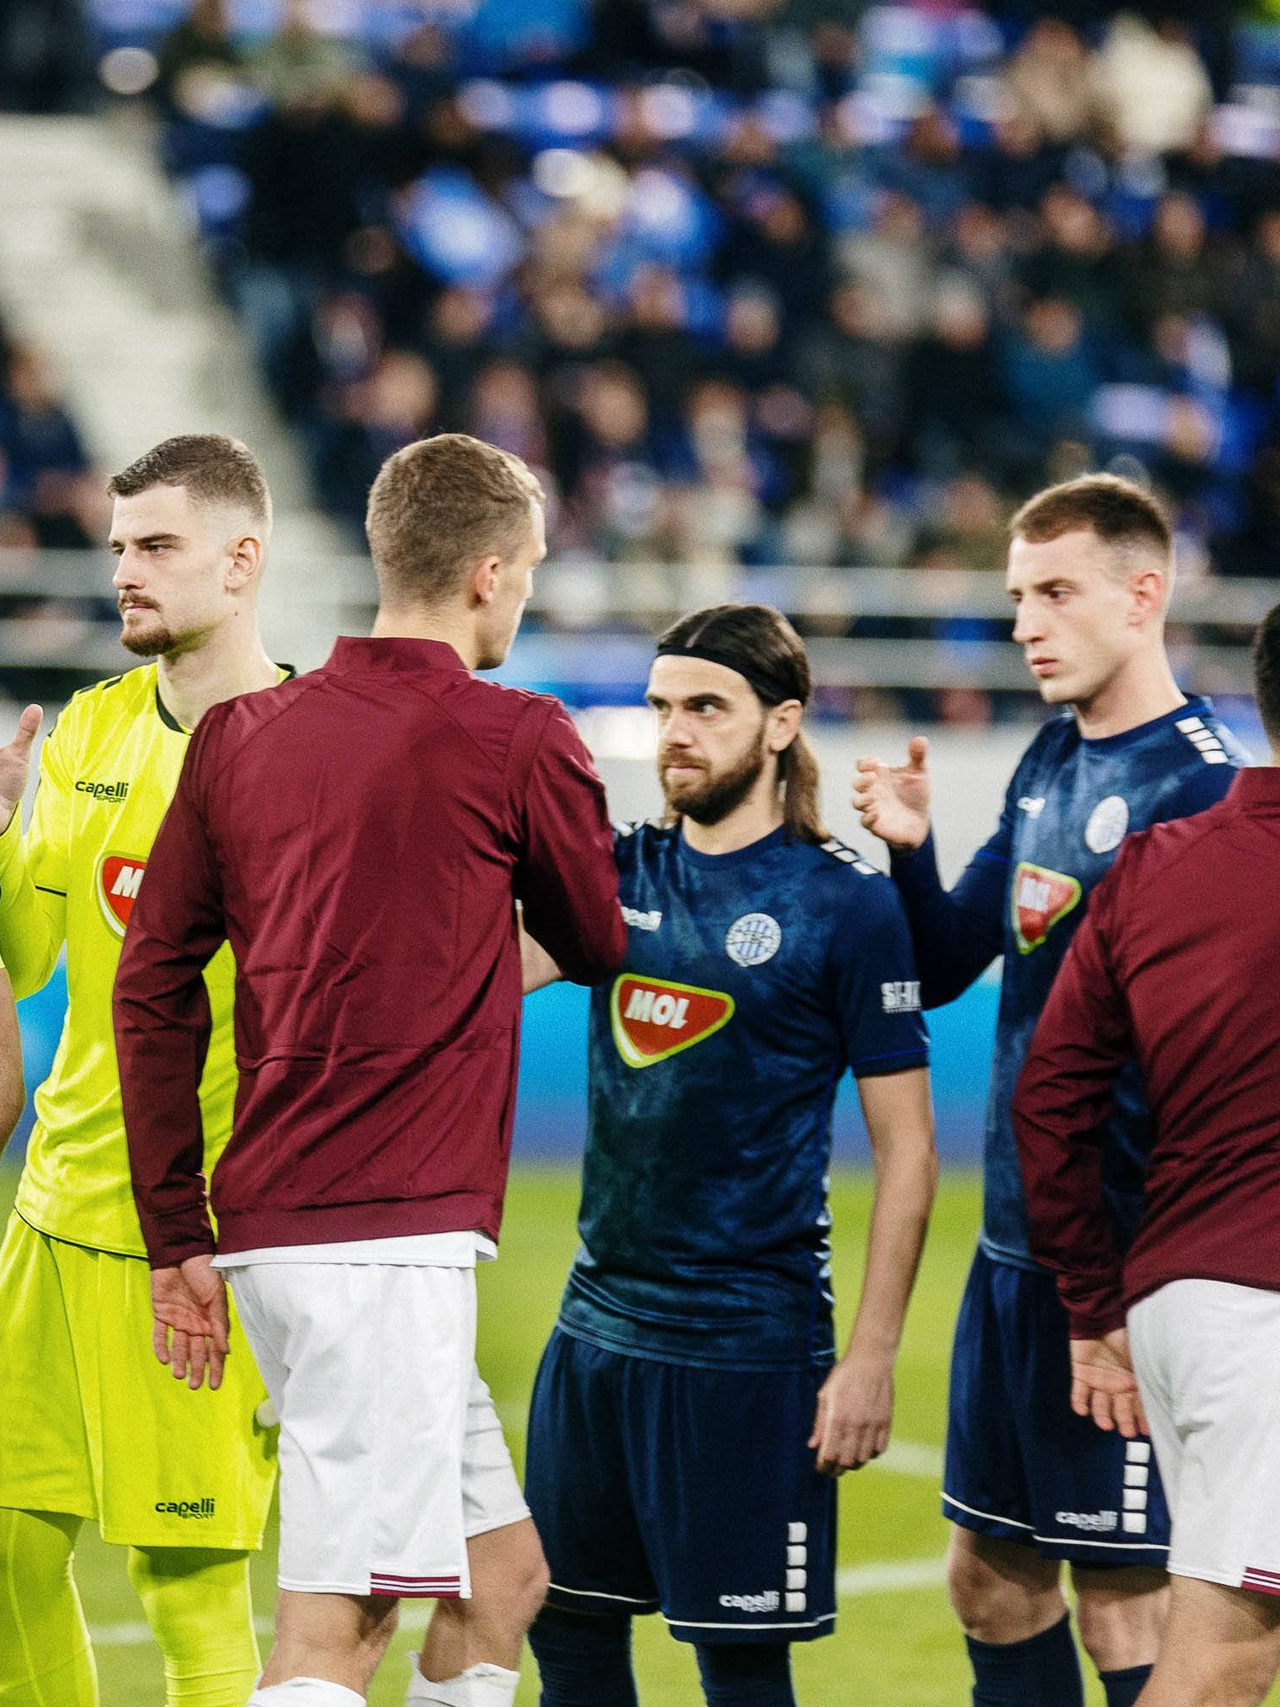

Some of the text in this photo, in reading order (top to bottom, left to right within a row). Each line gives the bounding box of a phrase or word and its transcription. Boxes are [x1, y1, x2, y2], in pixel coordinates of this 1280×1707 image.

[75, 781, 129, 798] capelli
[624, 988, 690, 1029] MOL
[155, 1498, 215, 1517] capelli
[1055, 1510, 1118, 1527] capelli
[719, 1591, 780, 1611] capelli
